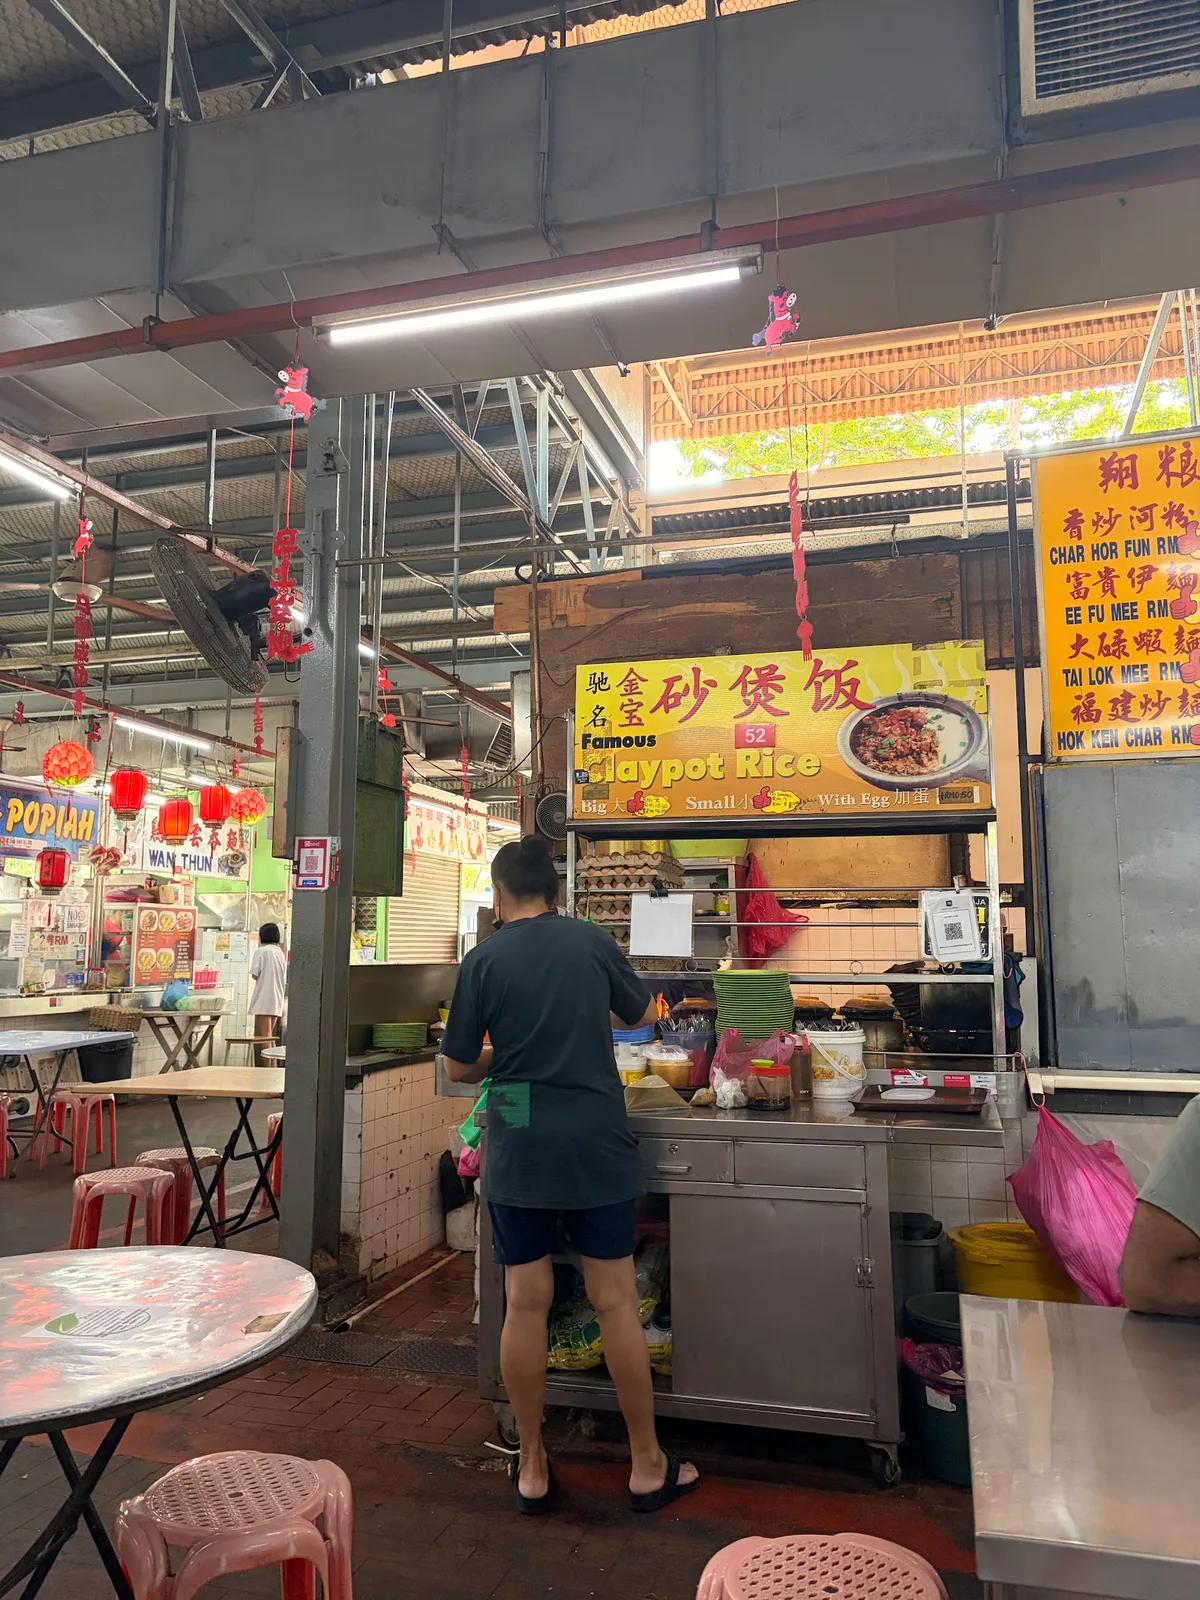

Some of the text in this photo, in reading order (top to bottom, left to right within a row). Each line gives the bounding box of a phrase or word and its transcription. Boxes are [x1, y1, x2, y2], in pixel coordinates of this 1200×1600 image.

[1050, 536, 1179, 565] CHAR HOR FUN RM
[1065, 599, 1168, 625] EE FU MEE RM
[1062, 661, 1180, 687] TAI LOK MEE RM
[584, 671, 611, 728] 驰名
[616, 667, 648, 728] 金宝
[649, 658, 876, 723] 砂煲饭
[581, 733, 656, 749] Famous
[745, 728, 766, 744] 52
[1057, 725, 1191, 750] HOK KEN CHAR RM
[736, 747, 822, 779] Rice
[581, 799, 607, 815] Big
[611, 797, 625, 813] 大
[686, 795, 735, 811] Small
[818, 793, 857, 807] With
[860, 793, 891, 809] Egg
[893, 787, 931, 806] 加蛋
[5, 797, 95, 841] POPIAH
[149, 849, 174, 868] WAN
[181, 853, 212, 872] THUN
